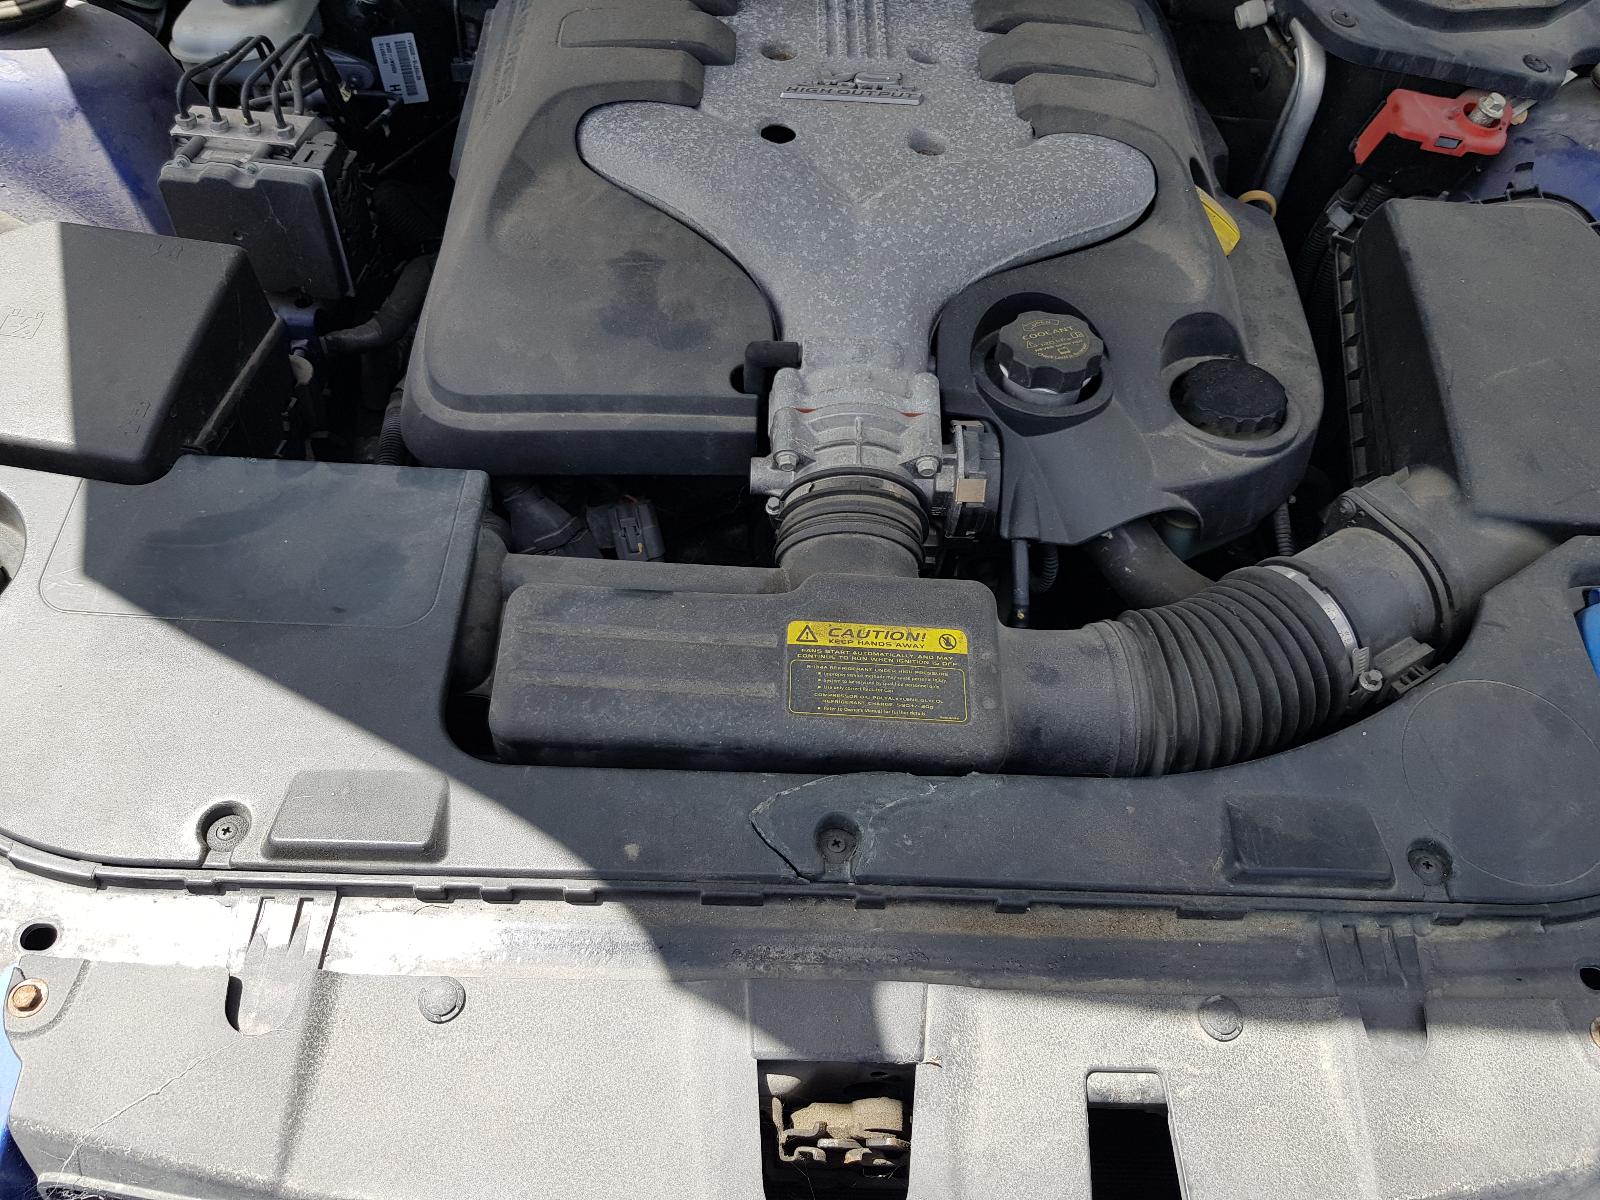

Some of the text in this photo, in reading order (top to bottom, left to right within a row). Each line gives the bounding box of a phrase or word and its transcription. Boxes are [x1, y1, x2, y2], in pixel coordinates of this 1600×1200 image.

[786, 86, 920, 98] HIGH OUTPUT
[1022, 326, 1074, 340] COOLANT
[828, 627, 927, 642] CAUTION!
[857, 639, 892, 647] HANDS
[895, 641, 925, 649] AWAY
